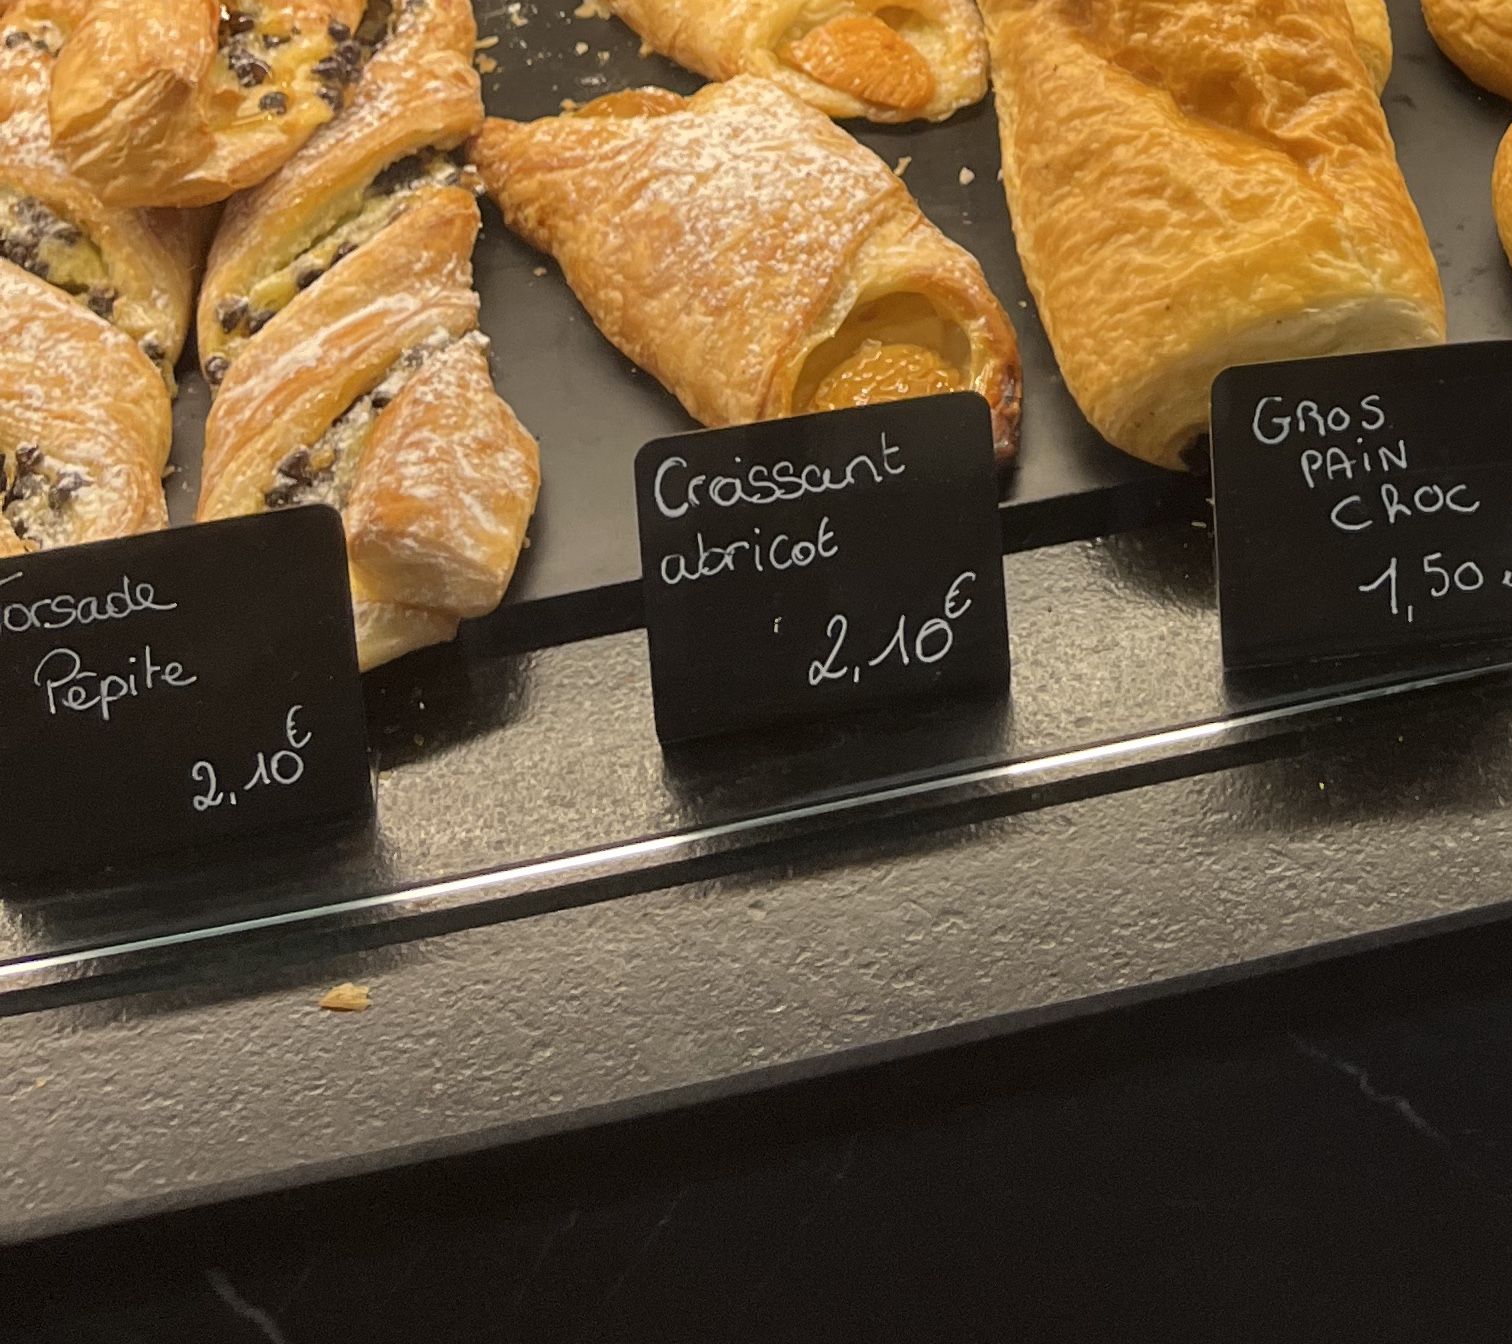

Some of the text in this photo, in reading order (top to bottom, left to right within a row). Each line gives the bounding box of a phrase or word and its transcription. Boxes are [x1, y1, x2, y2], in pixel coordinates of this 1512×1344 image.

[654, 431, 906, 519] Croissant
[1330, 483, 1481, 531] CROC
[660, 515, 838, 585] abricot
